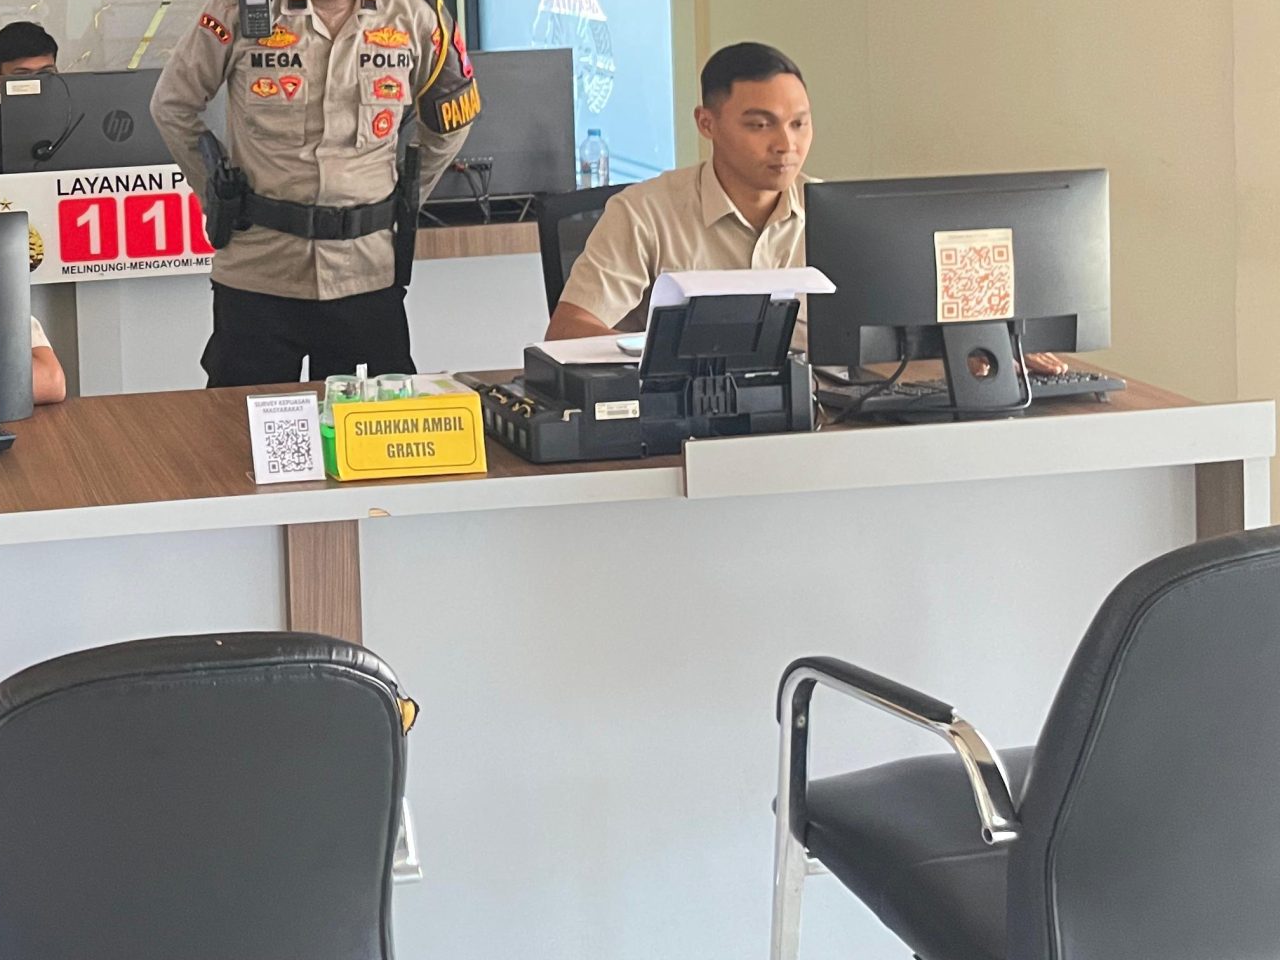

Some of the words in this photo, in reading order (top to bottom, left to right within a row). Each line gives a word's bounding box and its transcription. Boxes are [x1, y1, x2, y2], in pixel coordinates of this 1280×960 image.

[250, 52, 302, 69] MEGA
[359, 53, 410, 69] POLRI
[103, 109, 135, 143] hp
[57, 173, 163, 196] LAYANAN
[62, 256, 212, 275] MELINDUNGI-MENGAYOMI-ME
[355, 417, 419, 437] SILAHKAN
[422, 416, 464, 434] AMBIL
[386, 441, 436, 459] GRATIS
